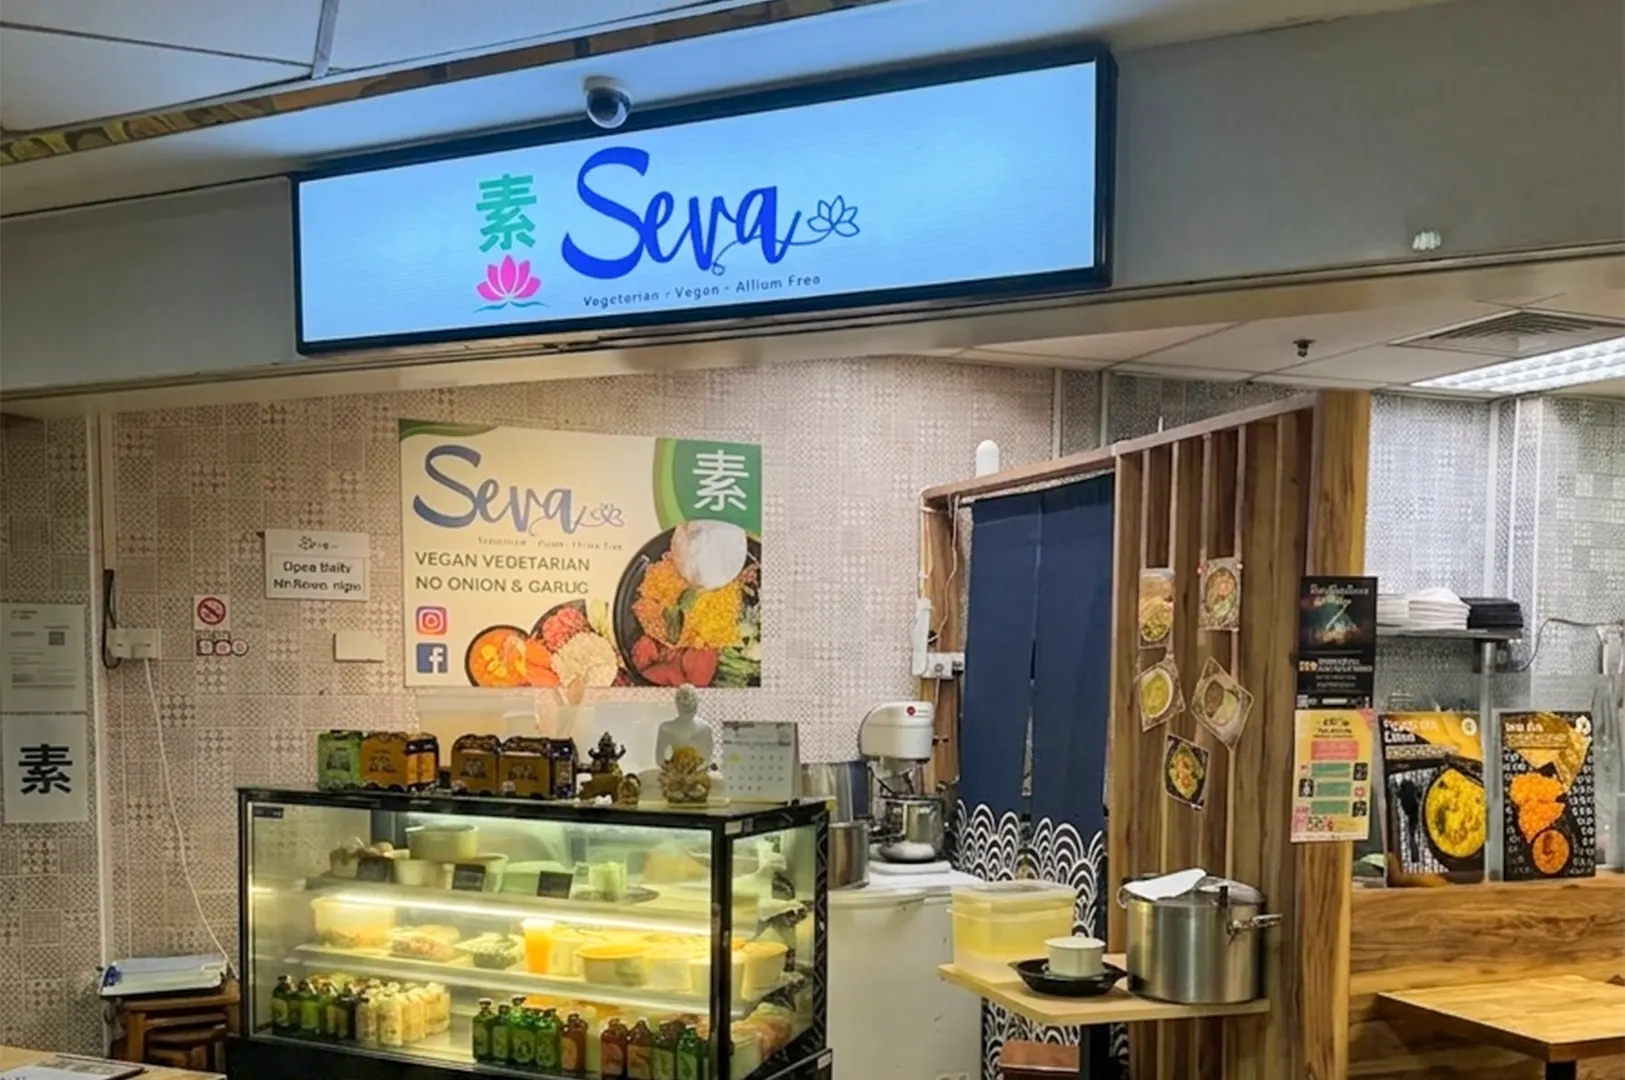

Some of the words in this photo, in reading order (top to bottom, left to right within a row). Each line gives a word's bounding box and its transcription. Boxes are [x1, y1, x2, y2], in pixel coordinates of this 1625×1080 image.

[476, 173, 537, 253] 素
[561, 146, 801, 279] Seva
[413, 444, 587, 535] Seva
[692, 449, 749, 511] 素
[415, 551, 478, 568] VEGAN
[416, 576, 442, 591] NO
[447, 577, 506, 592] ONION
[511, 579, 523, 594] &
[18, 744, 73, 794] 素
